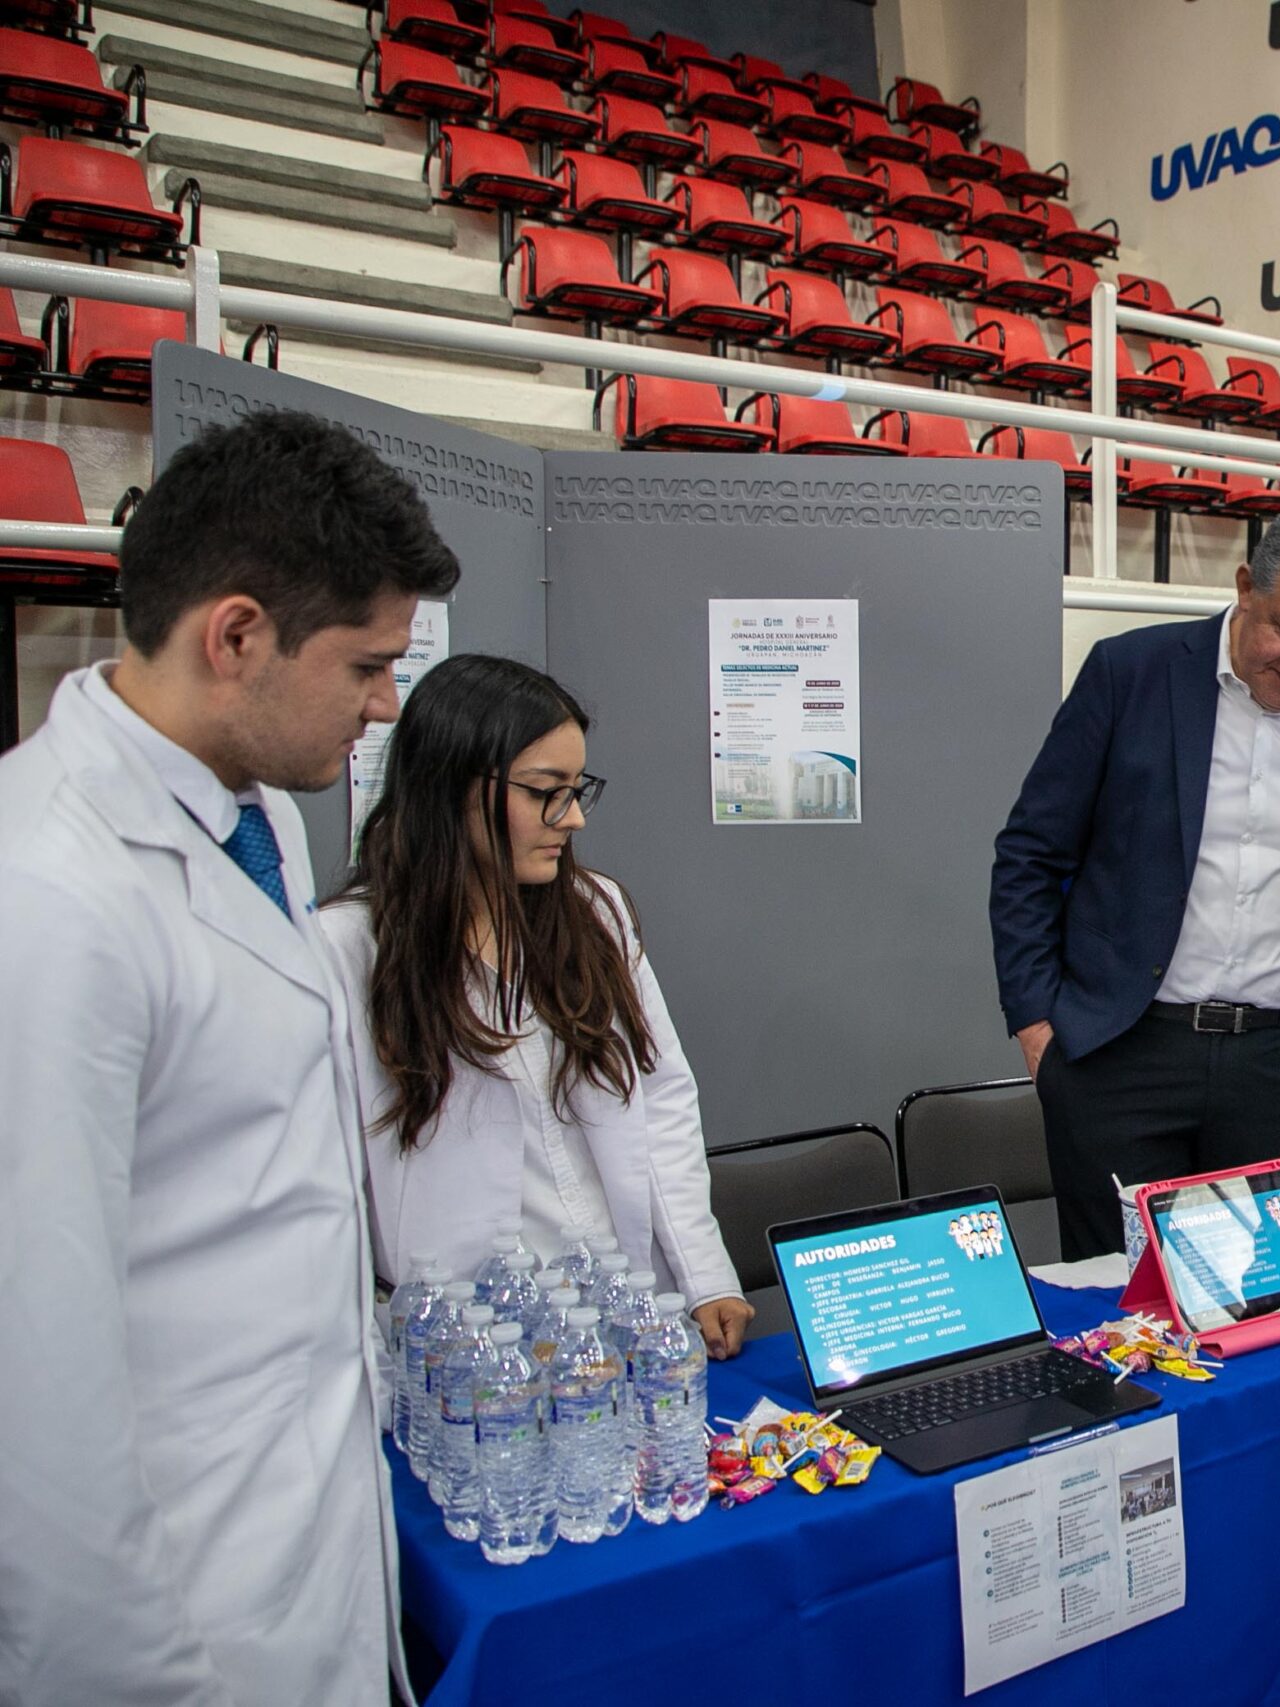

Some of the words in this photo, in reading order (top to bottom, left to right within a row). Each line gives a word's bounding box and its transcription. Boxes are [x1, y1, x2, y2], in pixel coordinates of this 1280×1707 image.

[554, 476, 634, 498] UVAQ
[638, 478, 716, 499] UVAQ
[720, 480, 798, 500] UVAQ
[802, 481, 880, 503] UVAQ
[883, 483, 961, 504] UVAQ
[965, 484, 1041, 506] UVAQ
[554, 502, 634, 524] UVAQ
[637, 503, 716, 525] UVAQ
[720, 505, 798, 526] UVAQ
[802, 506, 880, 527] UVAQ
[883, 508, 961, 529] UVAQ
[964, 509, 1041, 531] UVAQ
[795, 1234, 896, 1268] AUTORIDADES
[809, 1272, 842, 1284] DIRECTOR:
[843, 1266, 870, 1277] HOMERO
[899, 1257, 910, 1265] GIL
[811, 1284, 825, 1293] JEFE
[832, 1280, 841, 1288] DE
[814, 1288, 840, 1299] CAMPOS
[816, 1299, 829, 1308] JEFE
[865, 1284, 895, 1296] GABRIELA
[897, 1277, 930, 1289] ALEJANDRA
[930, 1271, 950, 1282] BUCIO
[811, 1316, 825, 1326] JEFE
[900, 1295, 919, 1304] HUGO
[818, 1303, 847, 1315] ESCOBAR
[825, 1330, 839, 1339] JEFE
[900, 1310, 925, 1321] VARGAS
[827, 1338, 841, 1347] JEFE
[844, 1330, 875, 1342] MEDICINA
[908, 1314, 940, 1327] FERNANDO
[942, 1308, 962, 1319] BUCIO
[935, 1323, 966, 1337] GREGORIO
[830, 1342, 857, 1354] ZAMORA
